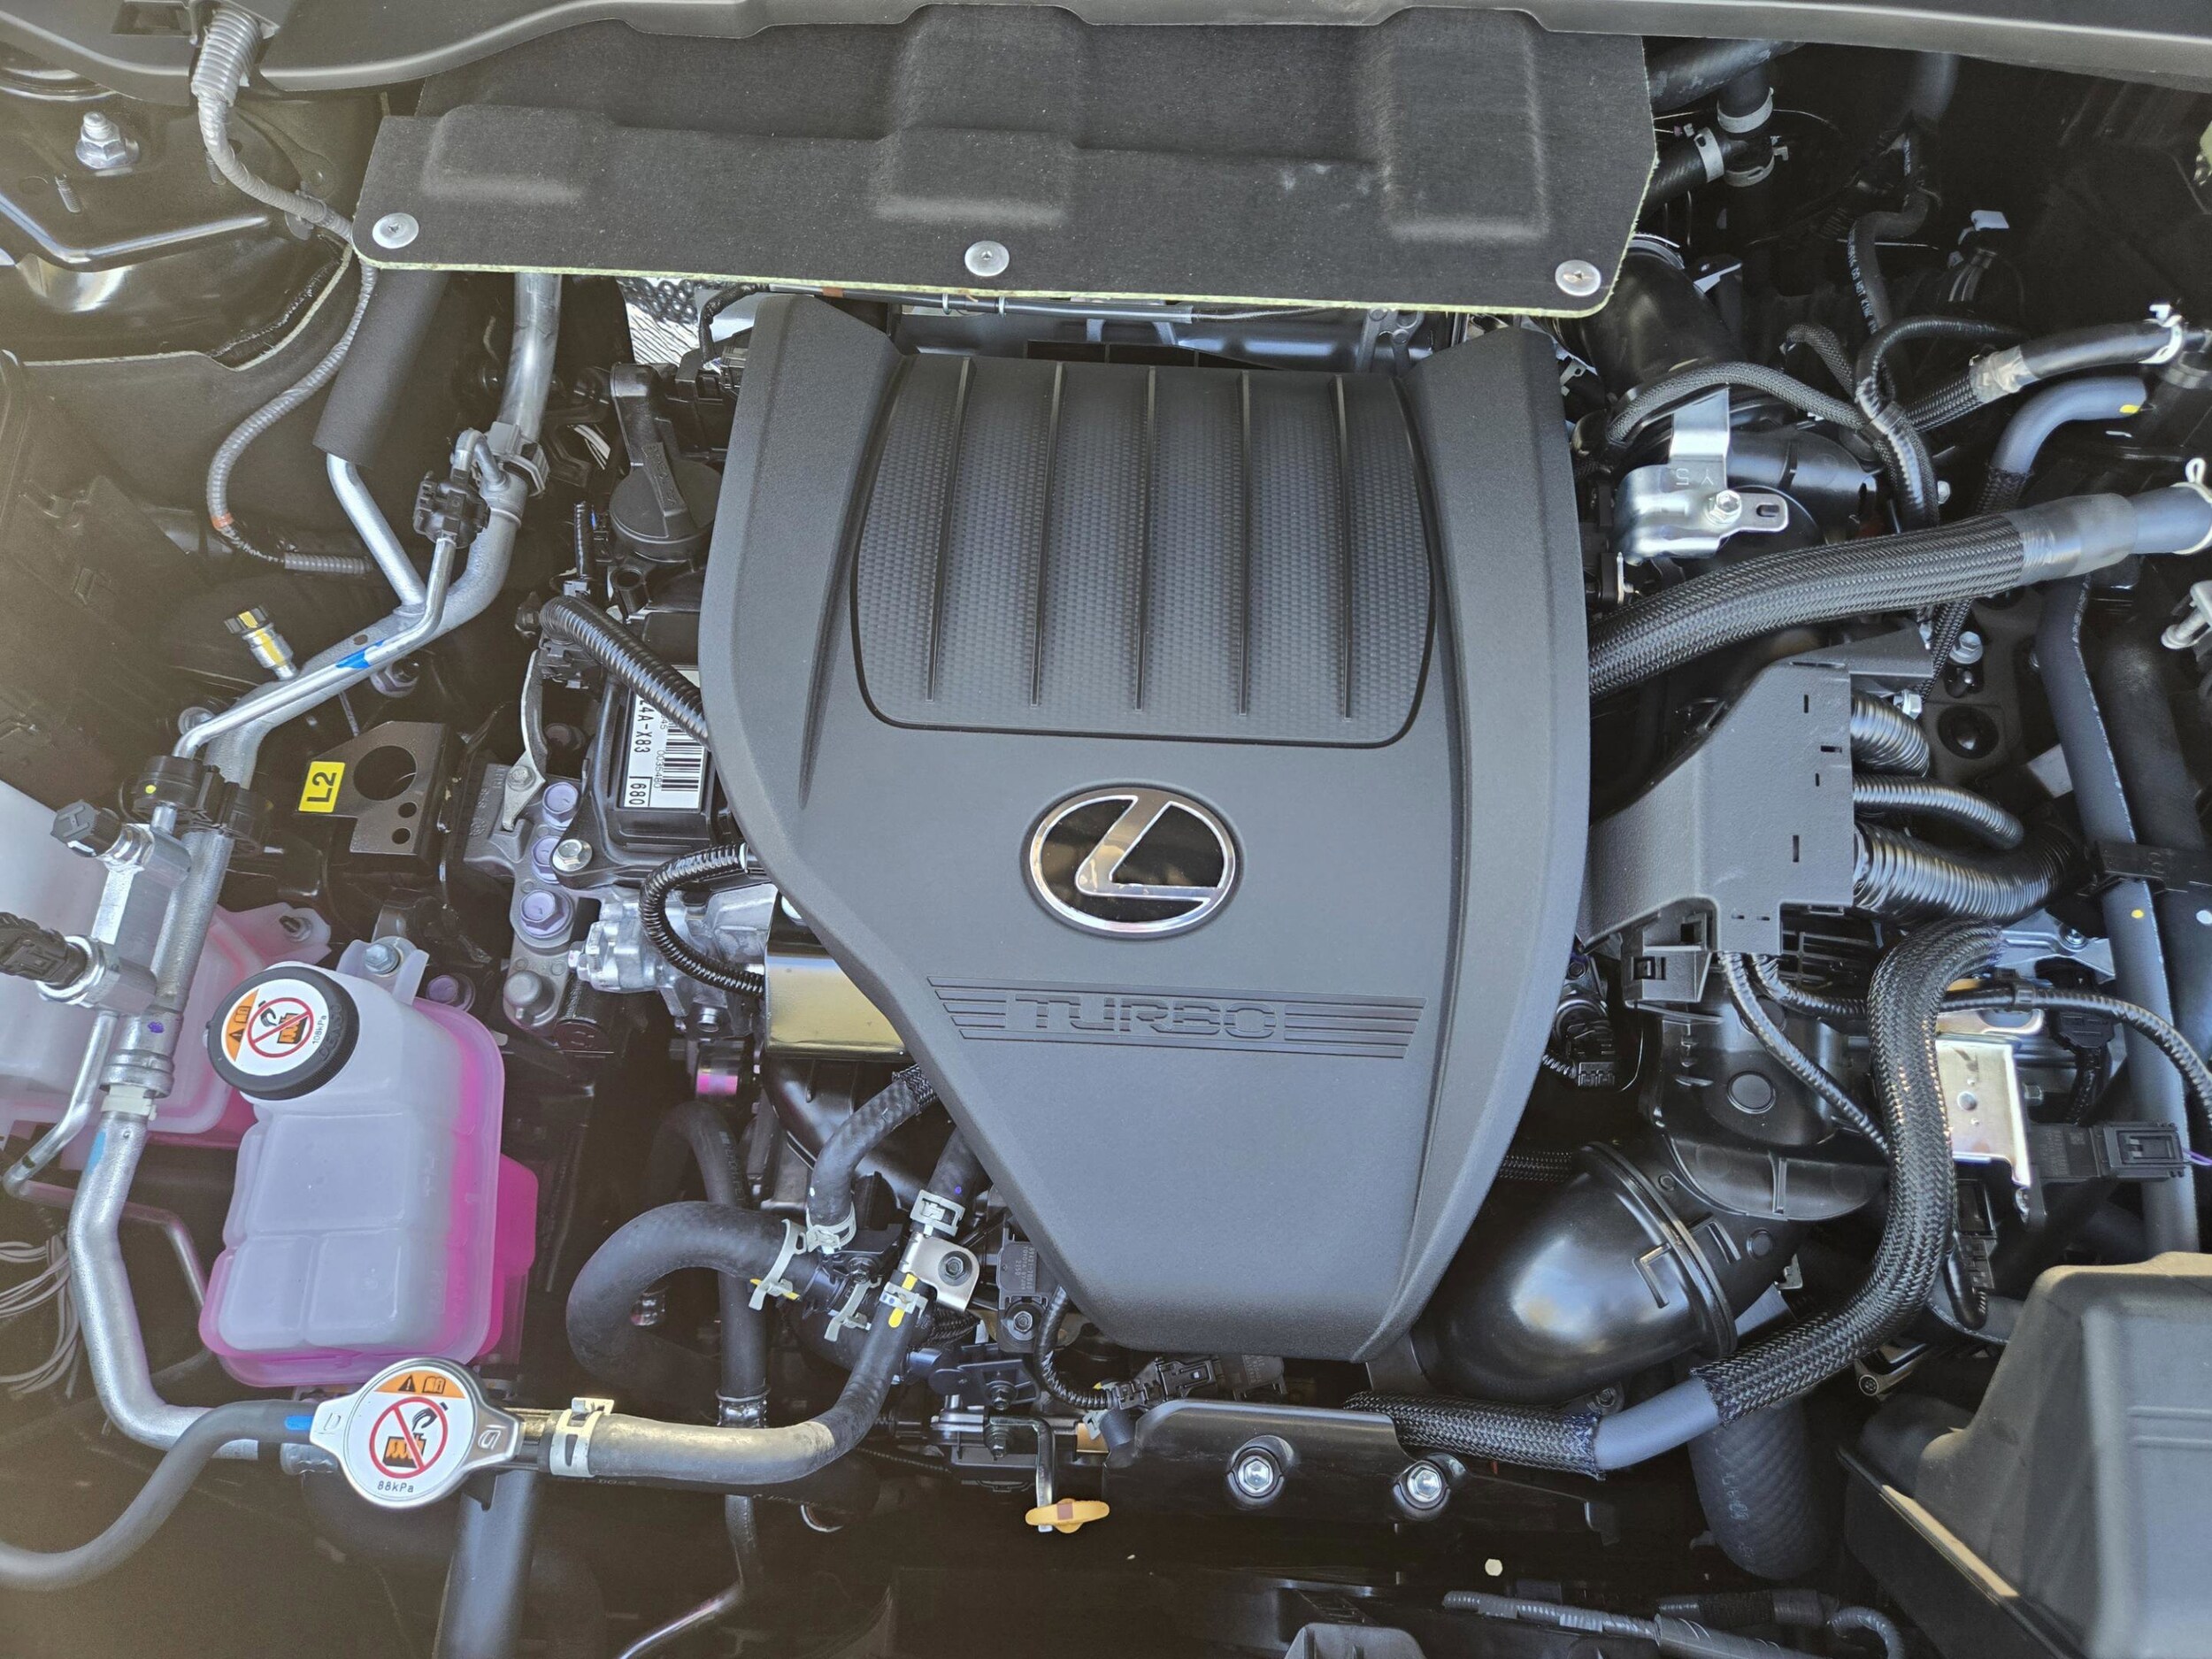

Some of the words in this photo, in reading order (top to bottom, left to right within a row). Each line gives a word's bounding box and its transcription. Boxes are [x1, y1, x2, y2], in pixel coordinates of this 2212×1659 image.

[653, 749, 665, 789] 0035480
[306, 772, 337, 803] L2
[628, 782, 647, 805] 680
[311, 1015, 327, 1045] 108kPa
[1015, 994, 1277, 1039] TURBO
[319, 1003, 345, 1062] DENSO
[377, 1480, 415, 1494] 88kPa
